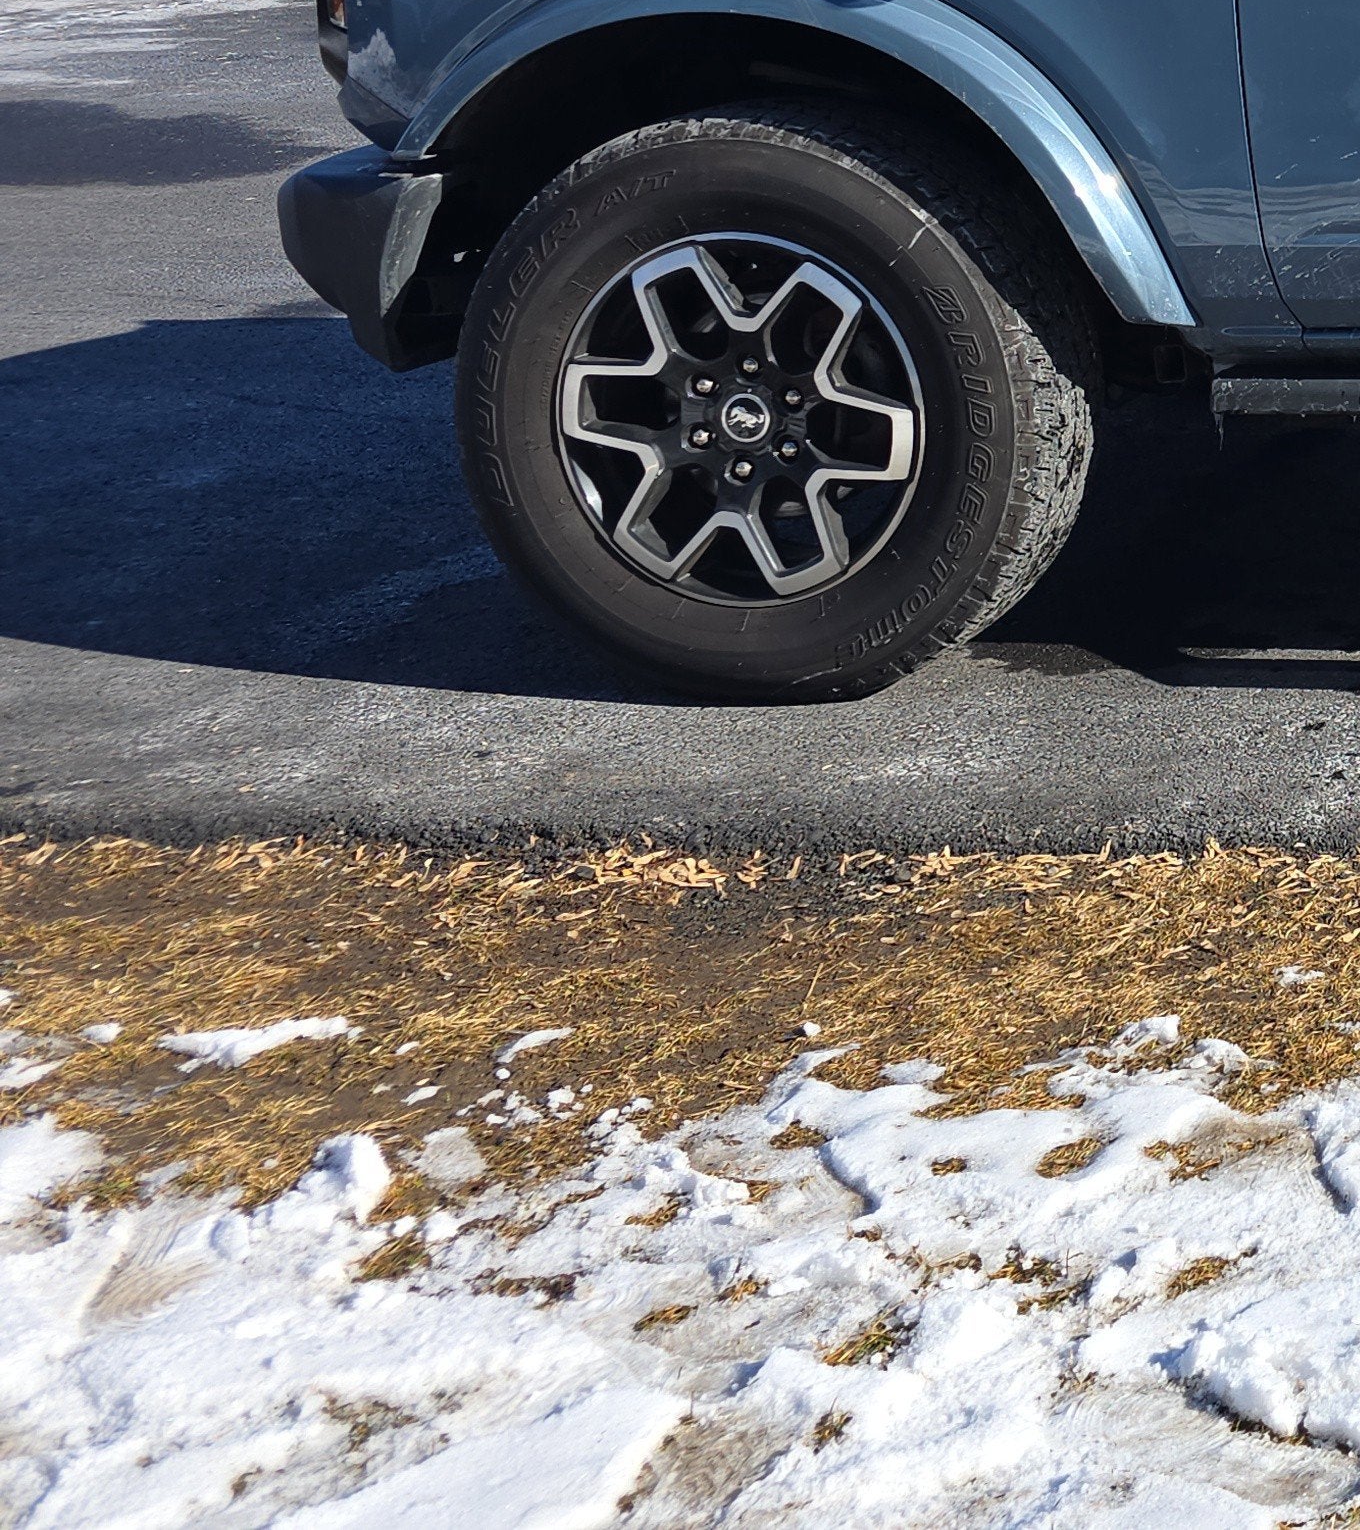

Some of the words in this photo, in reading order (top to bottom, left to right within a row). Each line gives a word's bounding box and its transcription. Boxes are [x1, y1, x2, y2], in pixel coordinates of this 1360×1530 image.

[476, 207, 582, 508] DUELER
[595, 170, 677, 216] A/T
[836, 282, 999, 670] BRIDGESTONE
